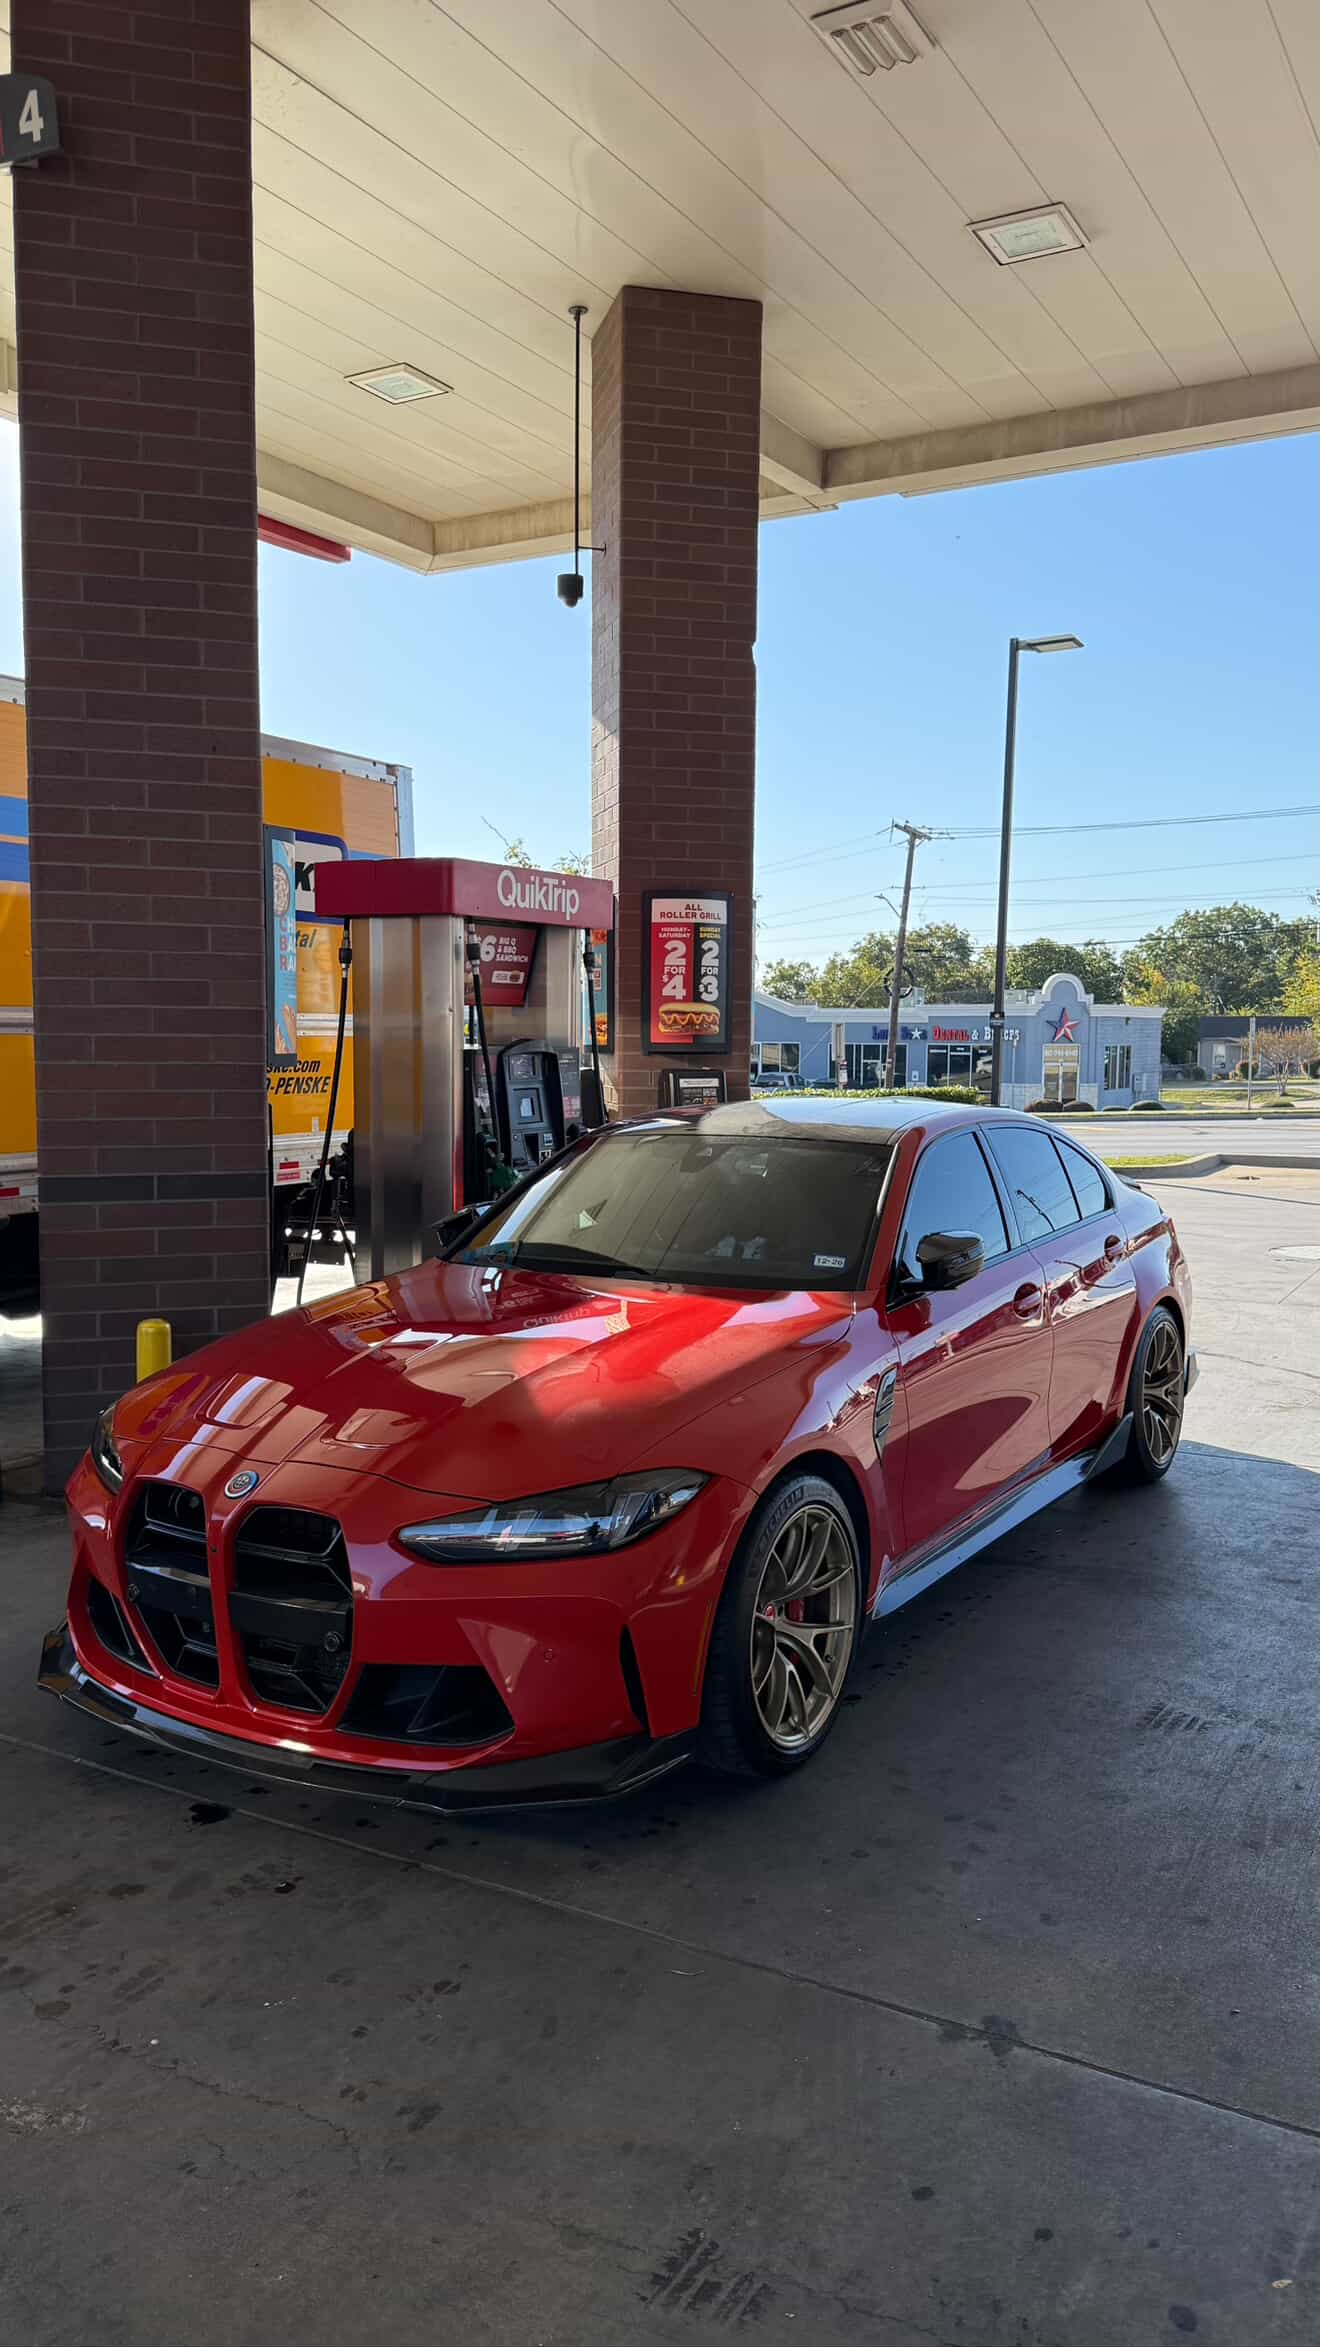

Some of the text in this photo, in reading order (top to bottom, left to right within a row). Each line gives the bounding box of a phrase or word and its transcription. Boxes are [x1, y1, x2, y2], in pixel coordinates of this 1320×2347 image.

[19, 88, 44, 143] 4
[497, 869, 580, 921] QuikTrip
[660, 911, 721, 920] ROLLER GRILL
[664, 940, 687, 966] 2
[701, 939, 720, 967] 2
[664, 966, 686, 975] FOR
[701, 966, 719, 975] FOR
[661, 974, 687, 1001] $4
[933, 1024, 970, 1041] DENTAL
[971, 1029, 979, 1041] &
[984, 1026, 1020, 1041] BCES
